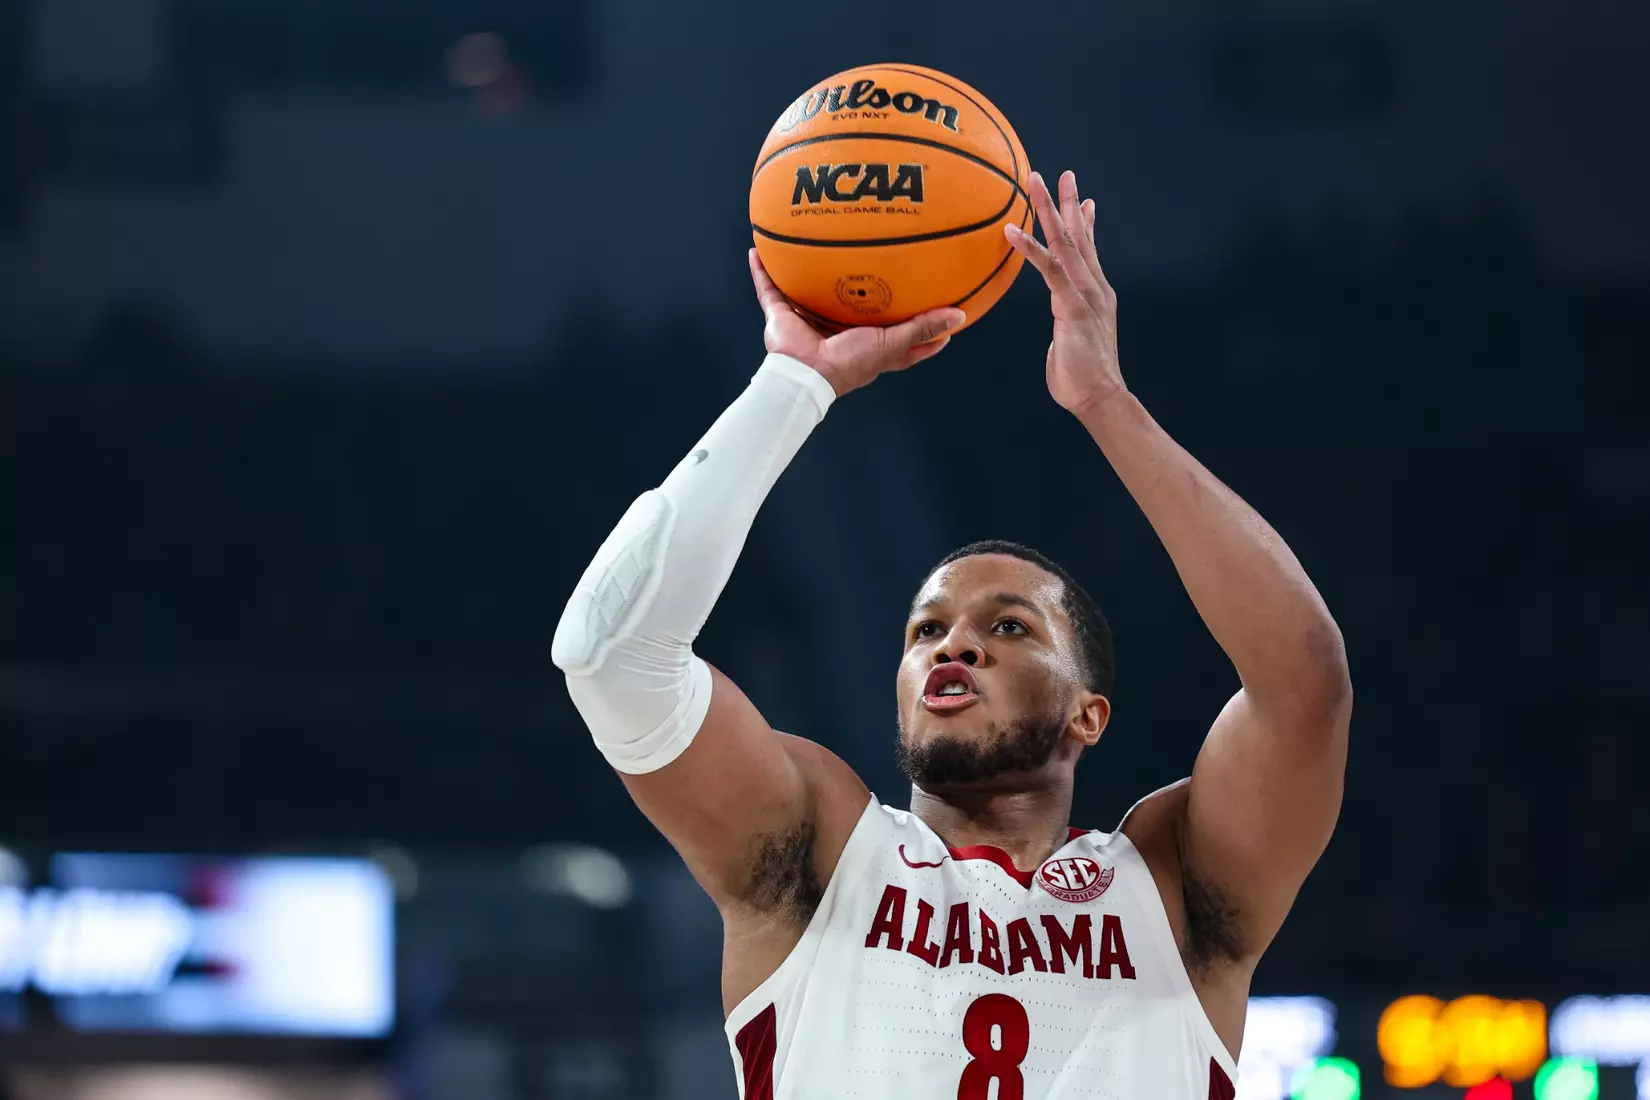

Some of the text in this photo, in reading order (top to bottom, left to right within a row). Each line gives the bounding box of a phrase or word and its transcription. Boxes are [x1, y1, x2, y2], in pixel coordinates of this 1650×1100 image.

[780, 79, 960, 133] Wilson
[832, 111, 889, 120] EVO NXT
[791, 163, 923, 206] NCAA
[791, 205, 921, 217] OFFICIAL GAME BALL
[1043, 858, 1097, 890] SEC
[865, 885, 1136, 980] ALABAMA
[957, 993, 1030, 1100] 8
